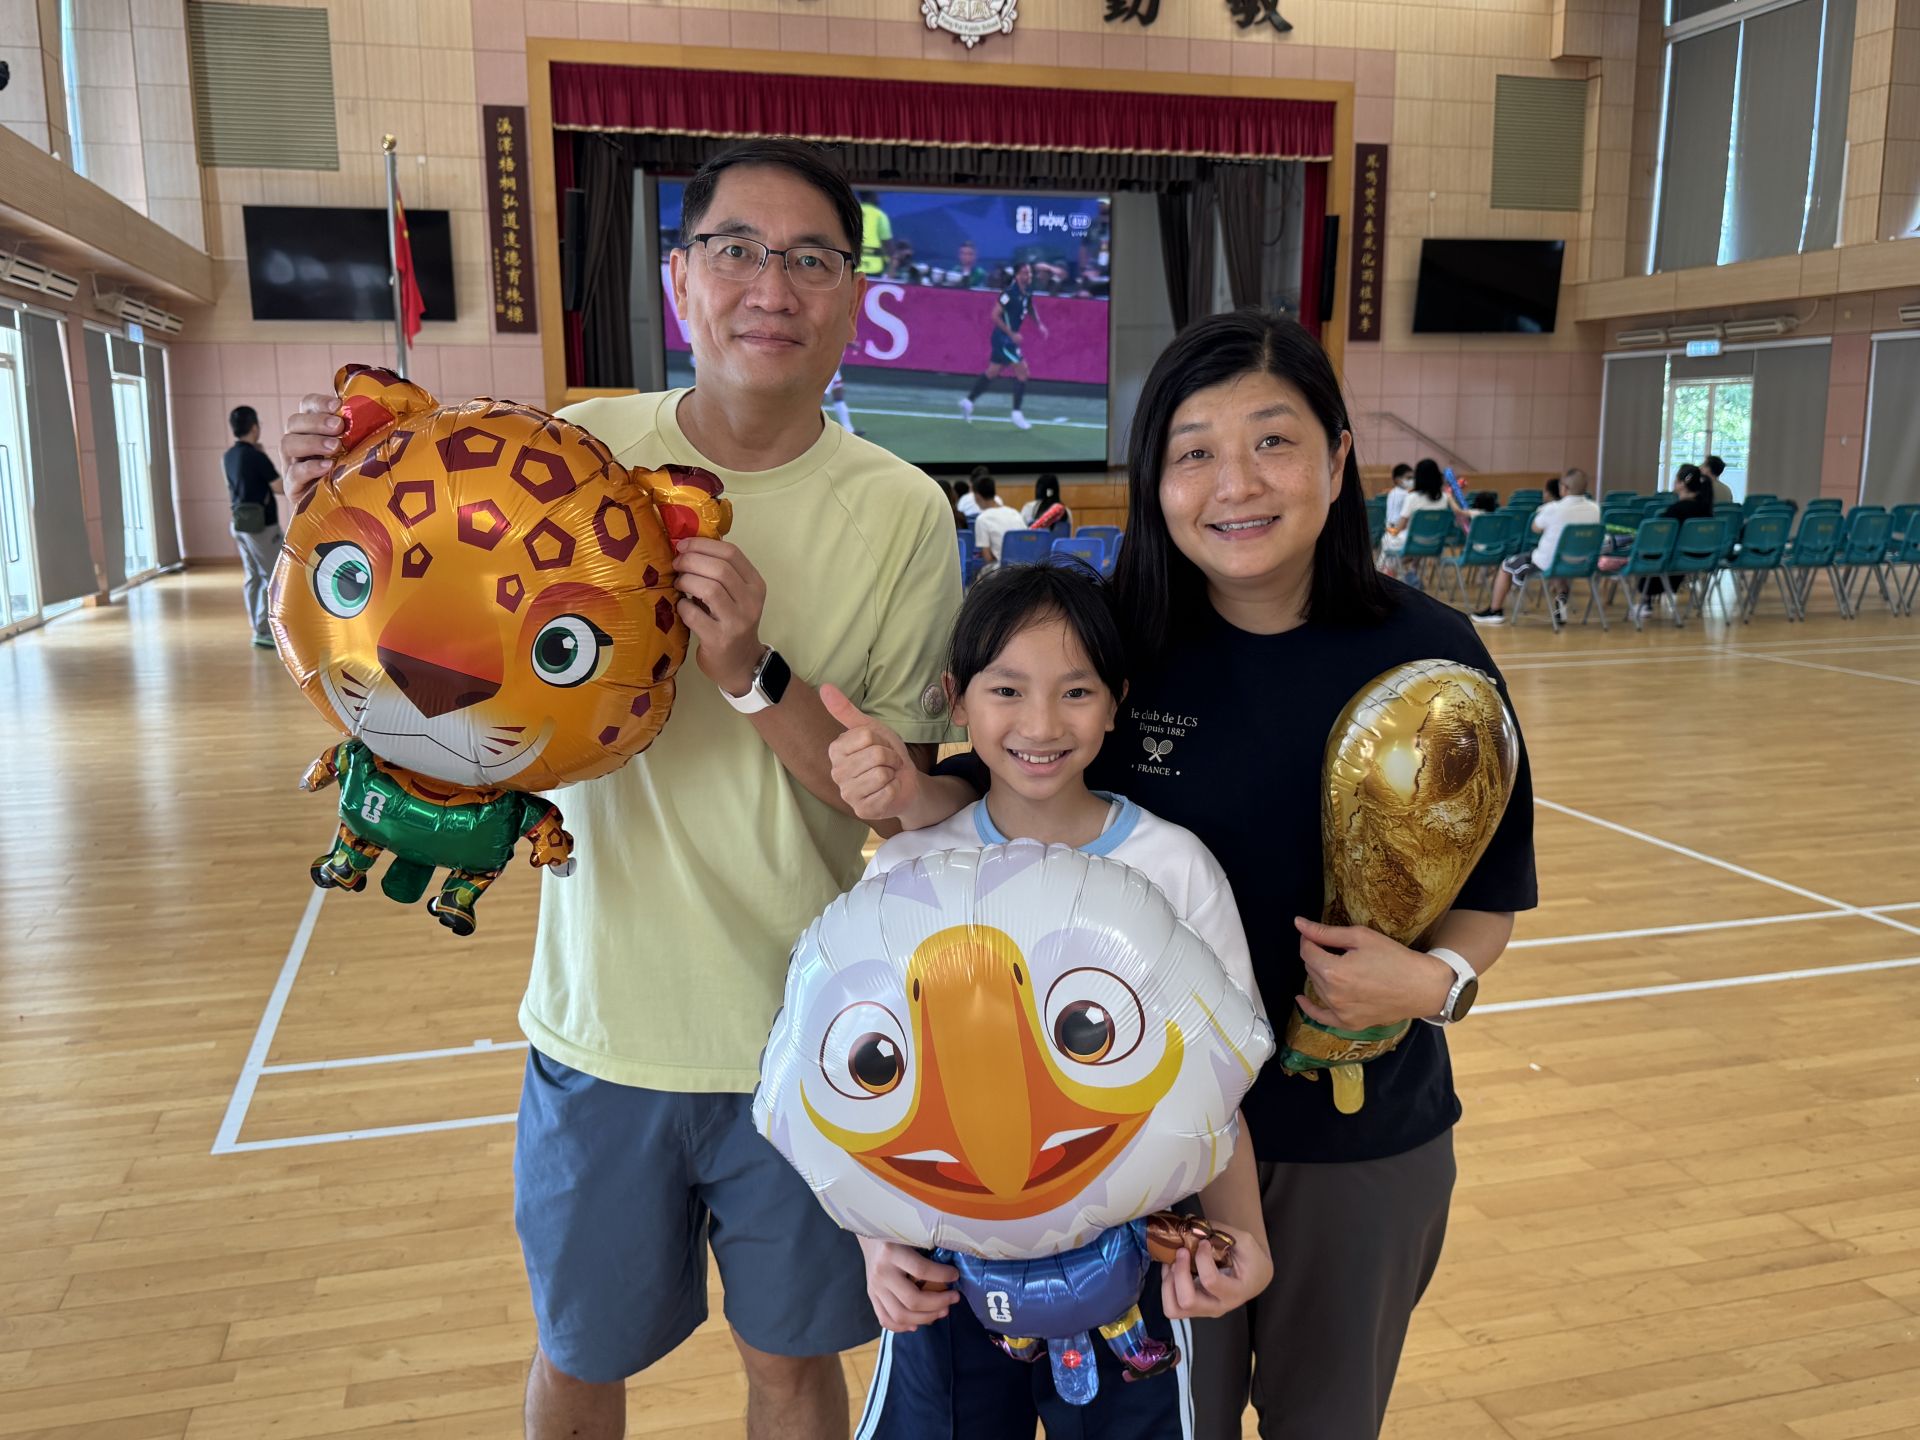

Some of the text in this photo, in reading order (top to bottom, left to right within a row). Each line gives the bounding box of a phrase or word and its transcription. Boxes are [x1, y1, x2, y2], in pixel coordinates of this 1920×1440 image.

[1131, 708, 1198, 727] le club de LCS
[1139, 722, 1186, 737] Depuis 1882
[1137, 763, 1171, 776] FRANCE
